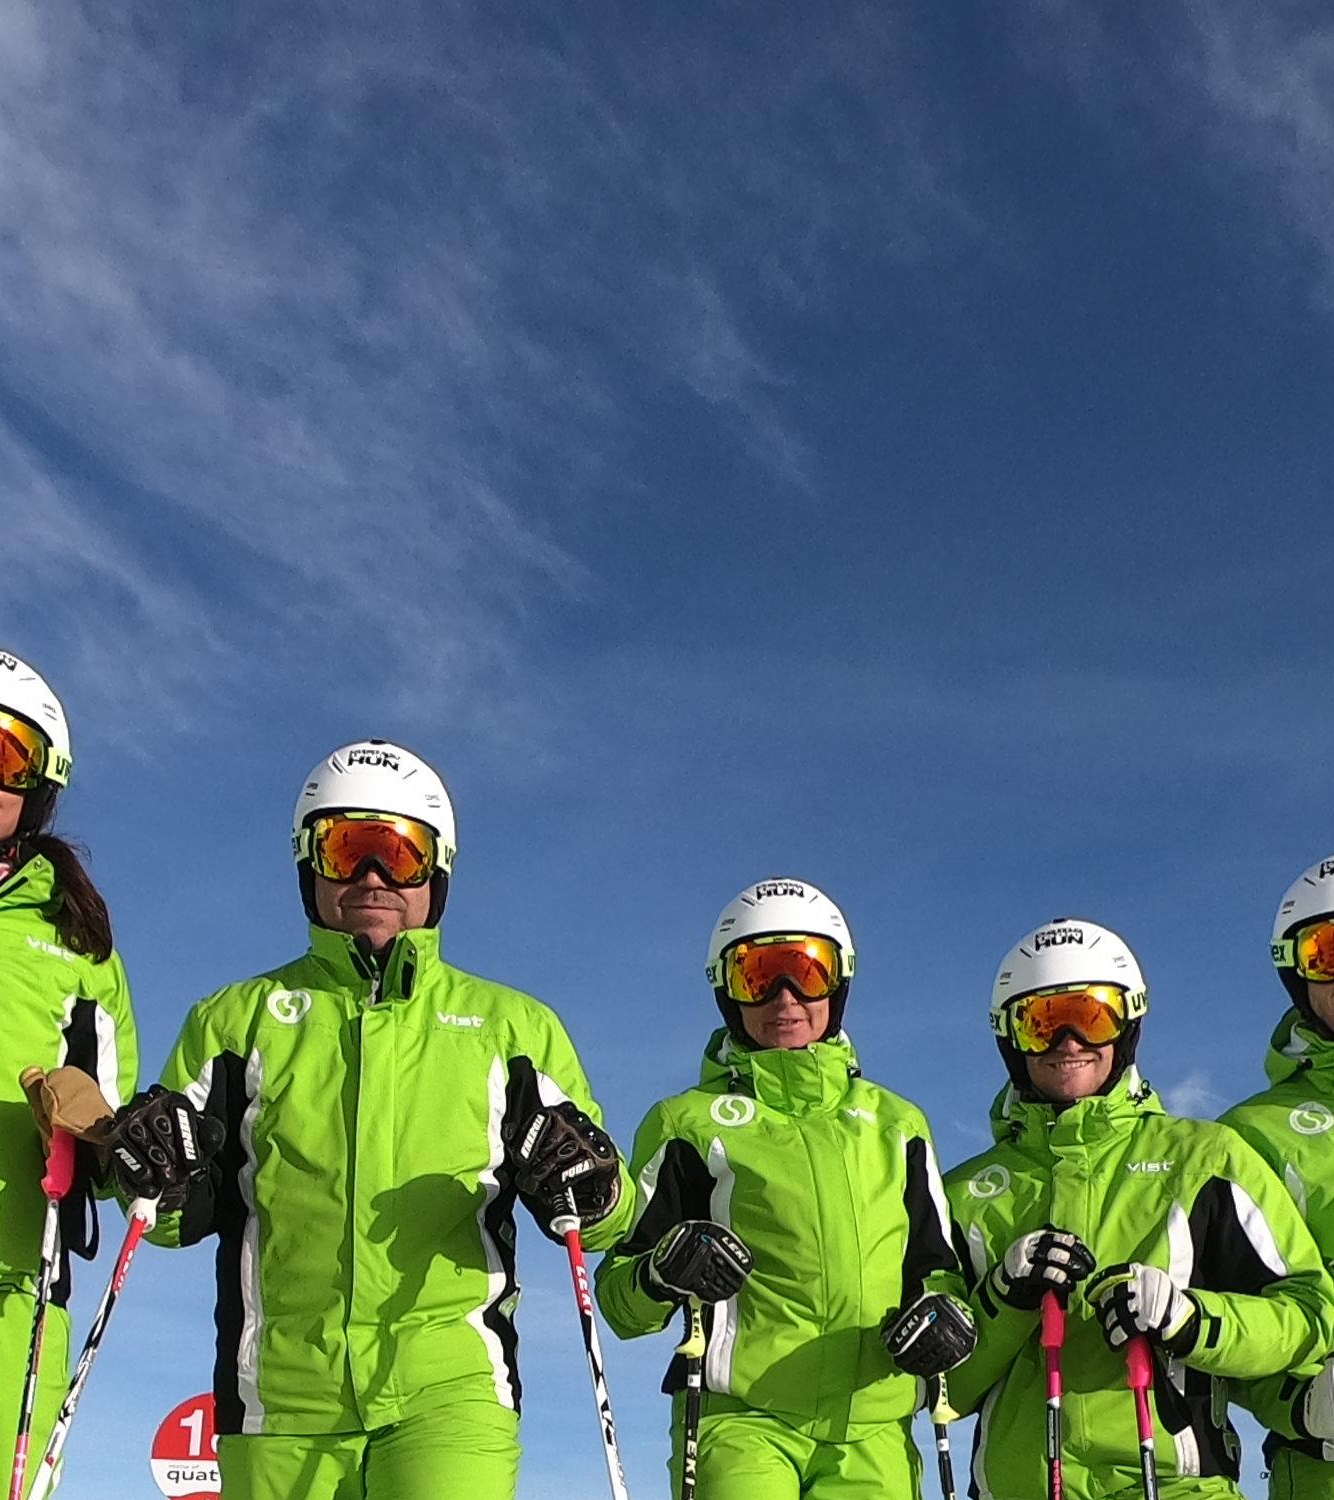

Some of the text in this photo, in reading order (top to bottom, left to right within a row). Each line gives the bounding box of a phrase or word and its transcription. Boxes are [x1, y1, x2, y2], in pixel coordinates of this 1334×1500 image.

[721, 1236, 749, 1264] LEKI
[895, 1314, 920, 1344] LEKI
[180, 1408, 219, 1456] 1
[167, 1469, 219, 1484] quat
